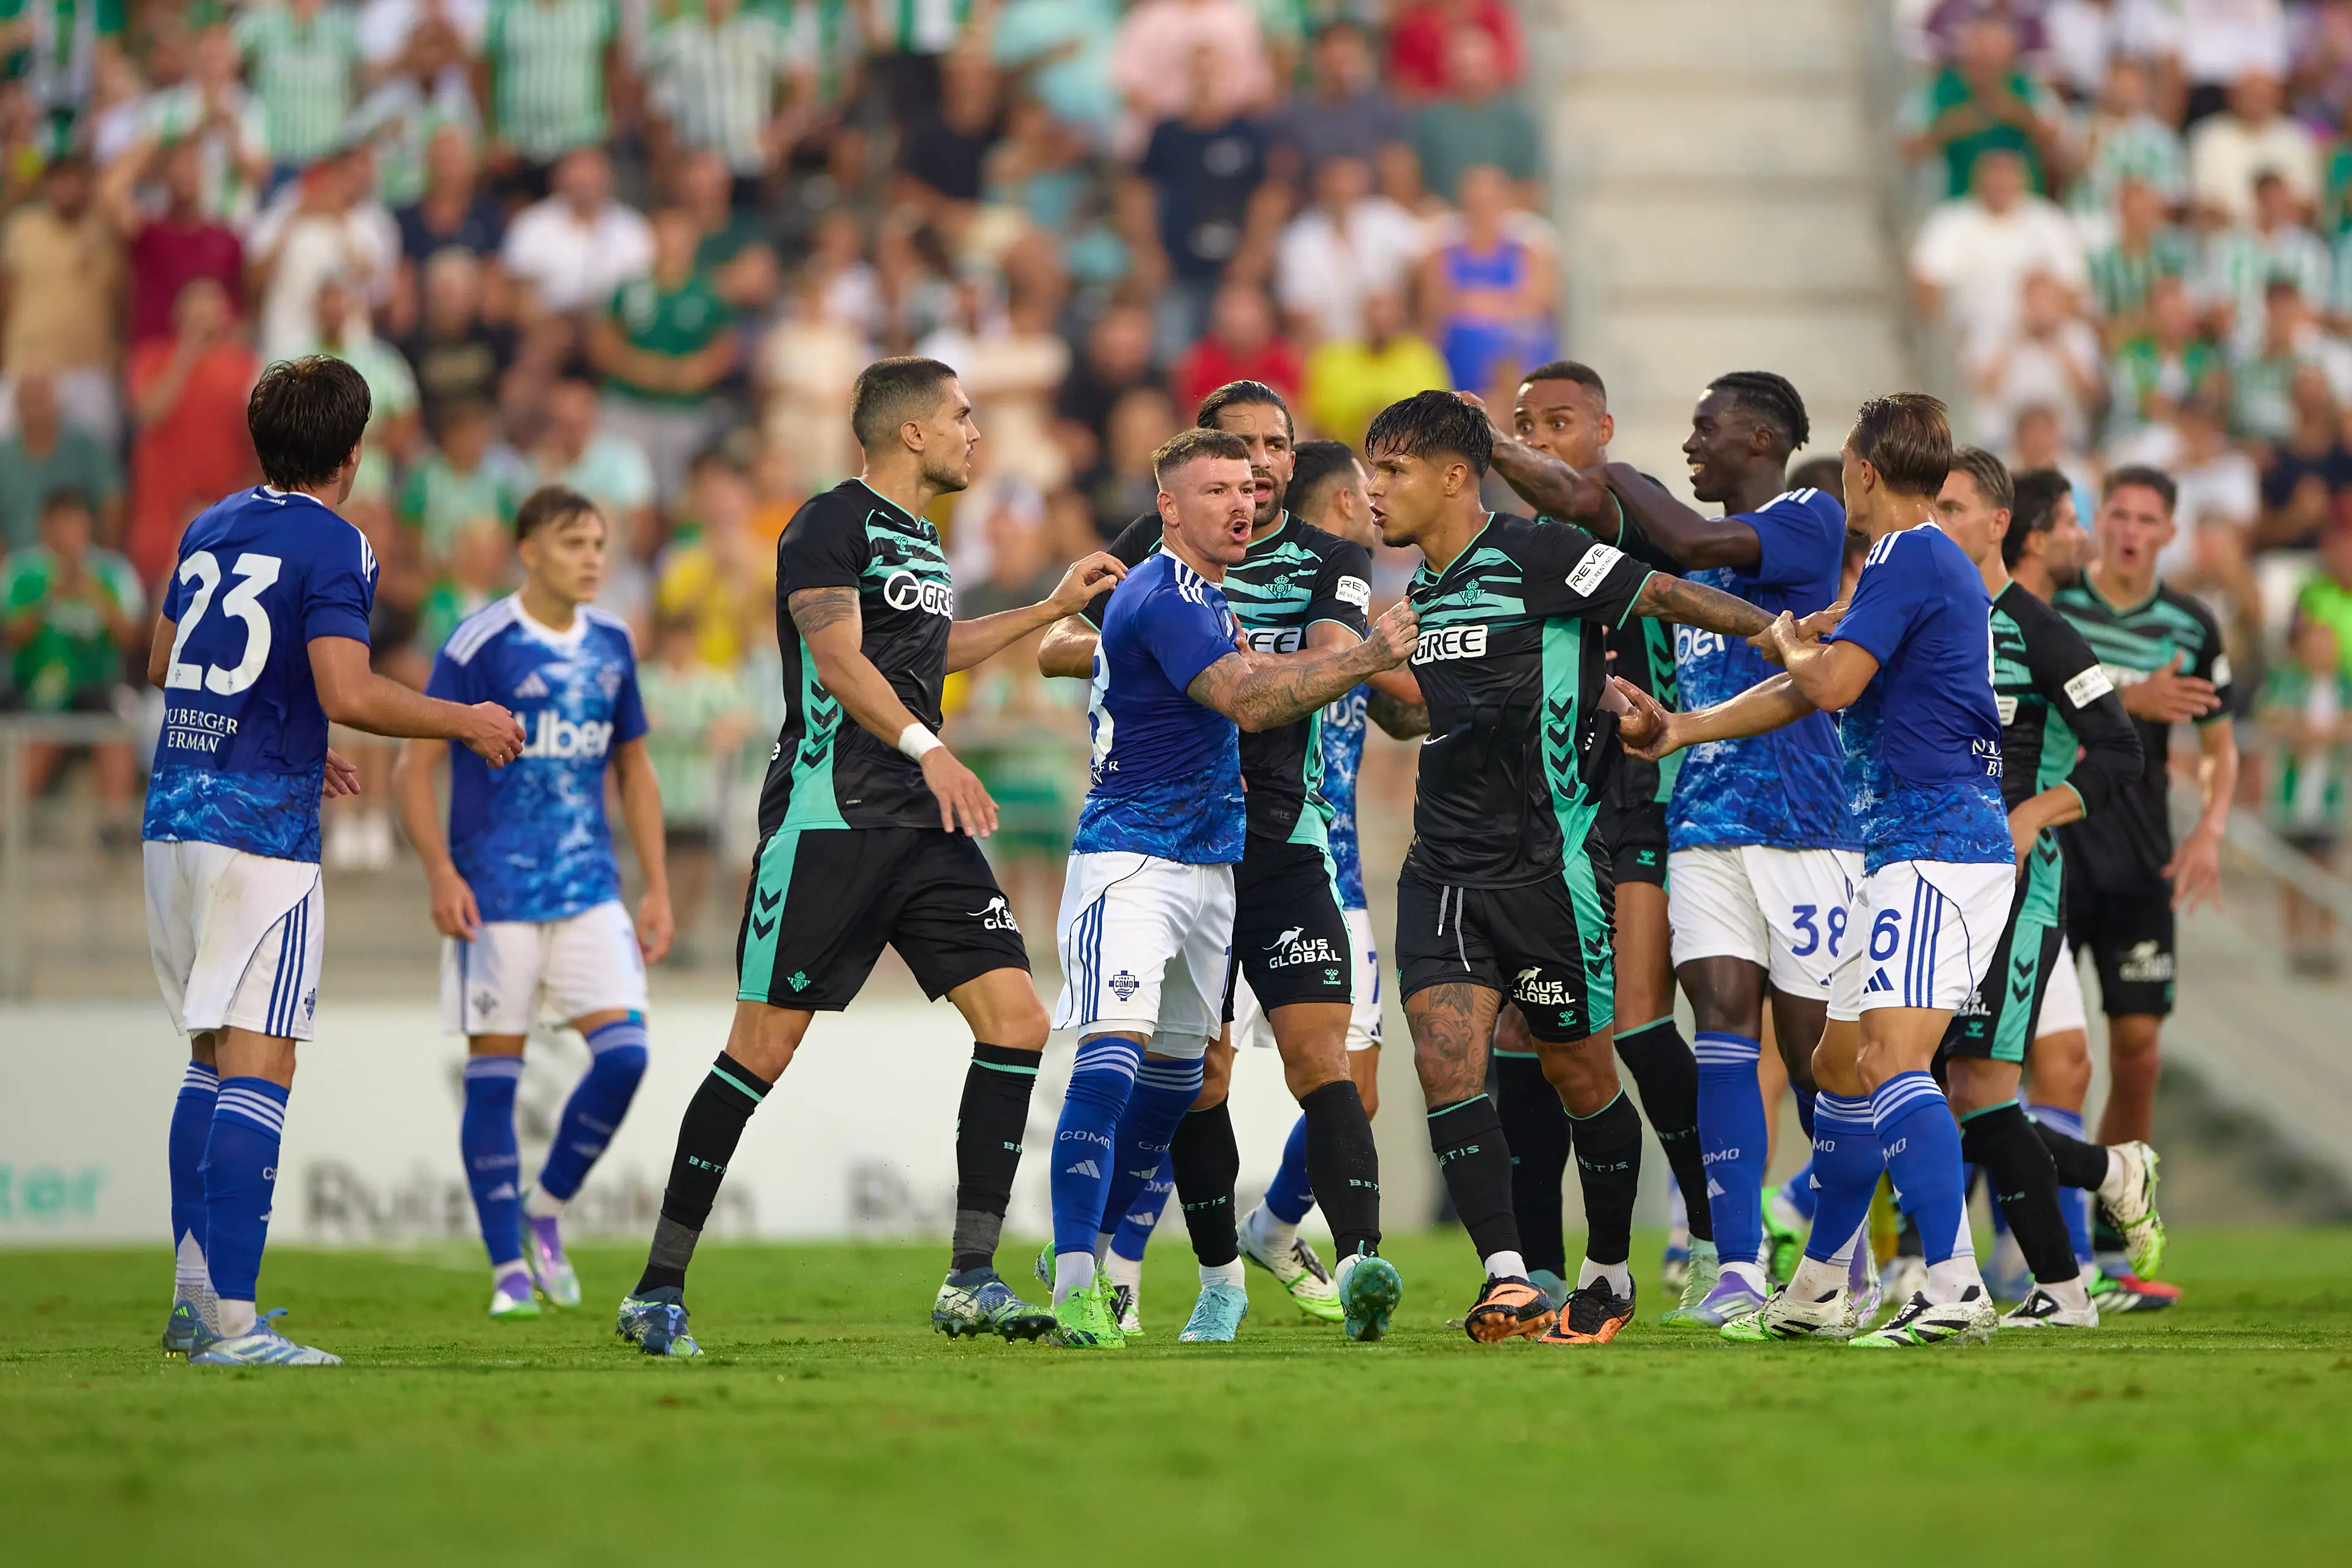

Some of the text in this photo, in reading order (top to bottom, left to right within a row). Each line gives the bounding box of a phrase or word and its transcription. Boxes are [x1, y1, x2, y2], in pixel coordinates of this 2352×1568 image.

[1570, 547, 1610, 587] REVEL
[1341, 579, 1369, 596] REV
[164, 550, 281, 696] 23
[1414, 629, 1483, 661] GREE
[166, 708, 238, 734] UBERGER
[167, 731, 220, 754] ERMAN
[513, 709, 614, 758] Uber
[1791, 905, 1847, 958] 38
[1869, 908, 1902, 962] 6
[1289, 939, 1329, 954] AUS
[1269, 949, 1342, 969] GLOBAL
[1513, 989, 1576, 1005] GLOBAL
[1527, 981, 1563, 993] AUS
[1812, 1136, 1836, 1152] MO
[1883, 1137, 1907, 1163] MO
[688, 1155, 727, 1175] BETI
[1439, 1145, 1479, 1170] ETIS
[1703, 1148, 1740, 1166] OMO
[1349, 1179, 1380, 1194] BET
